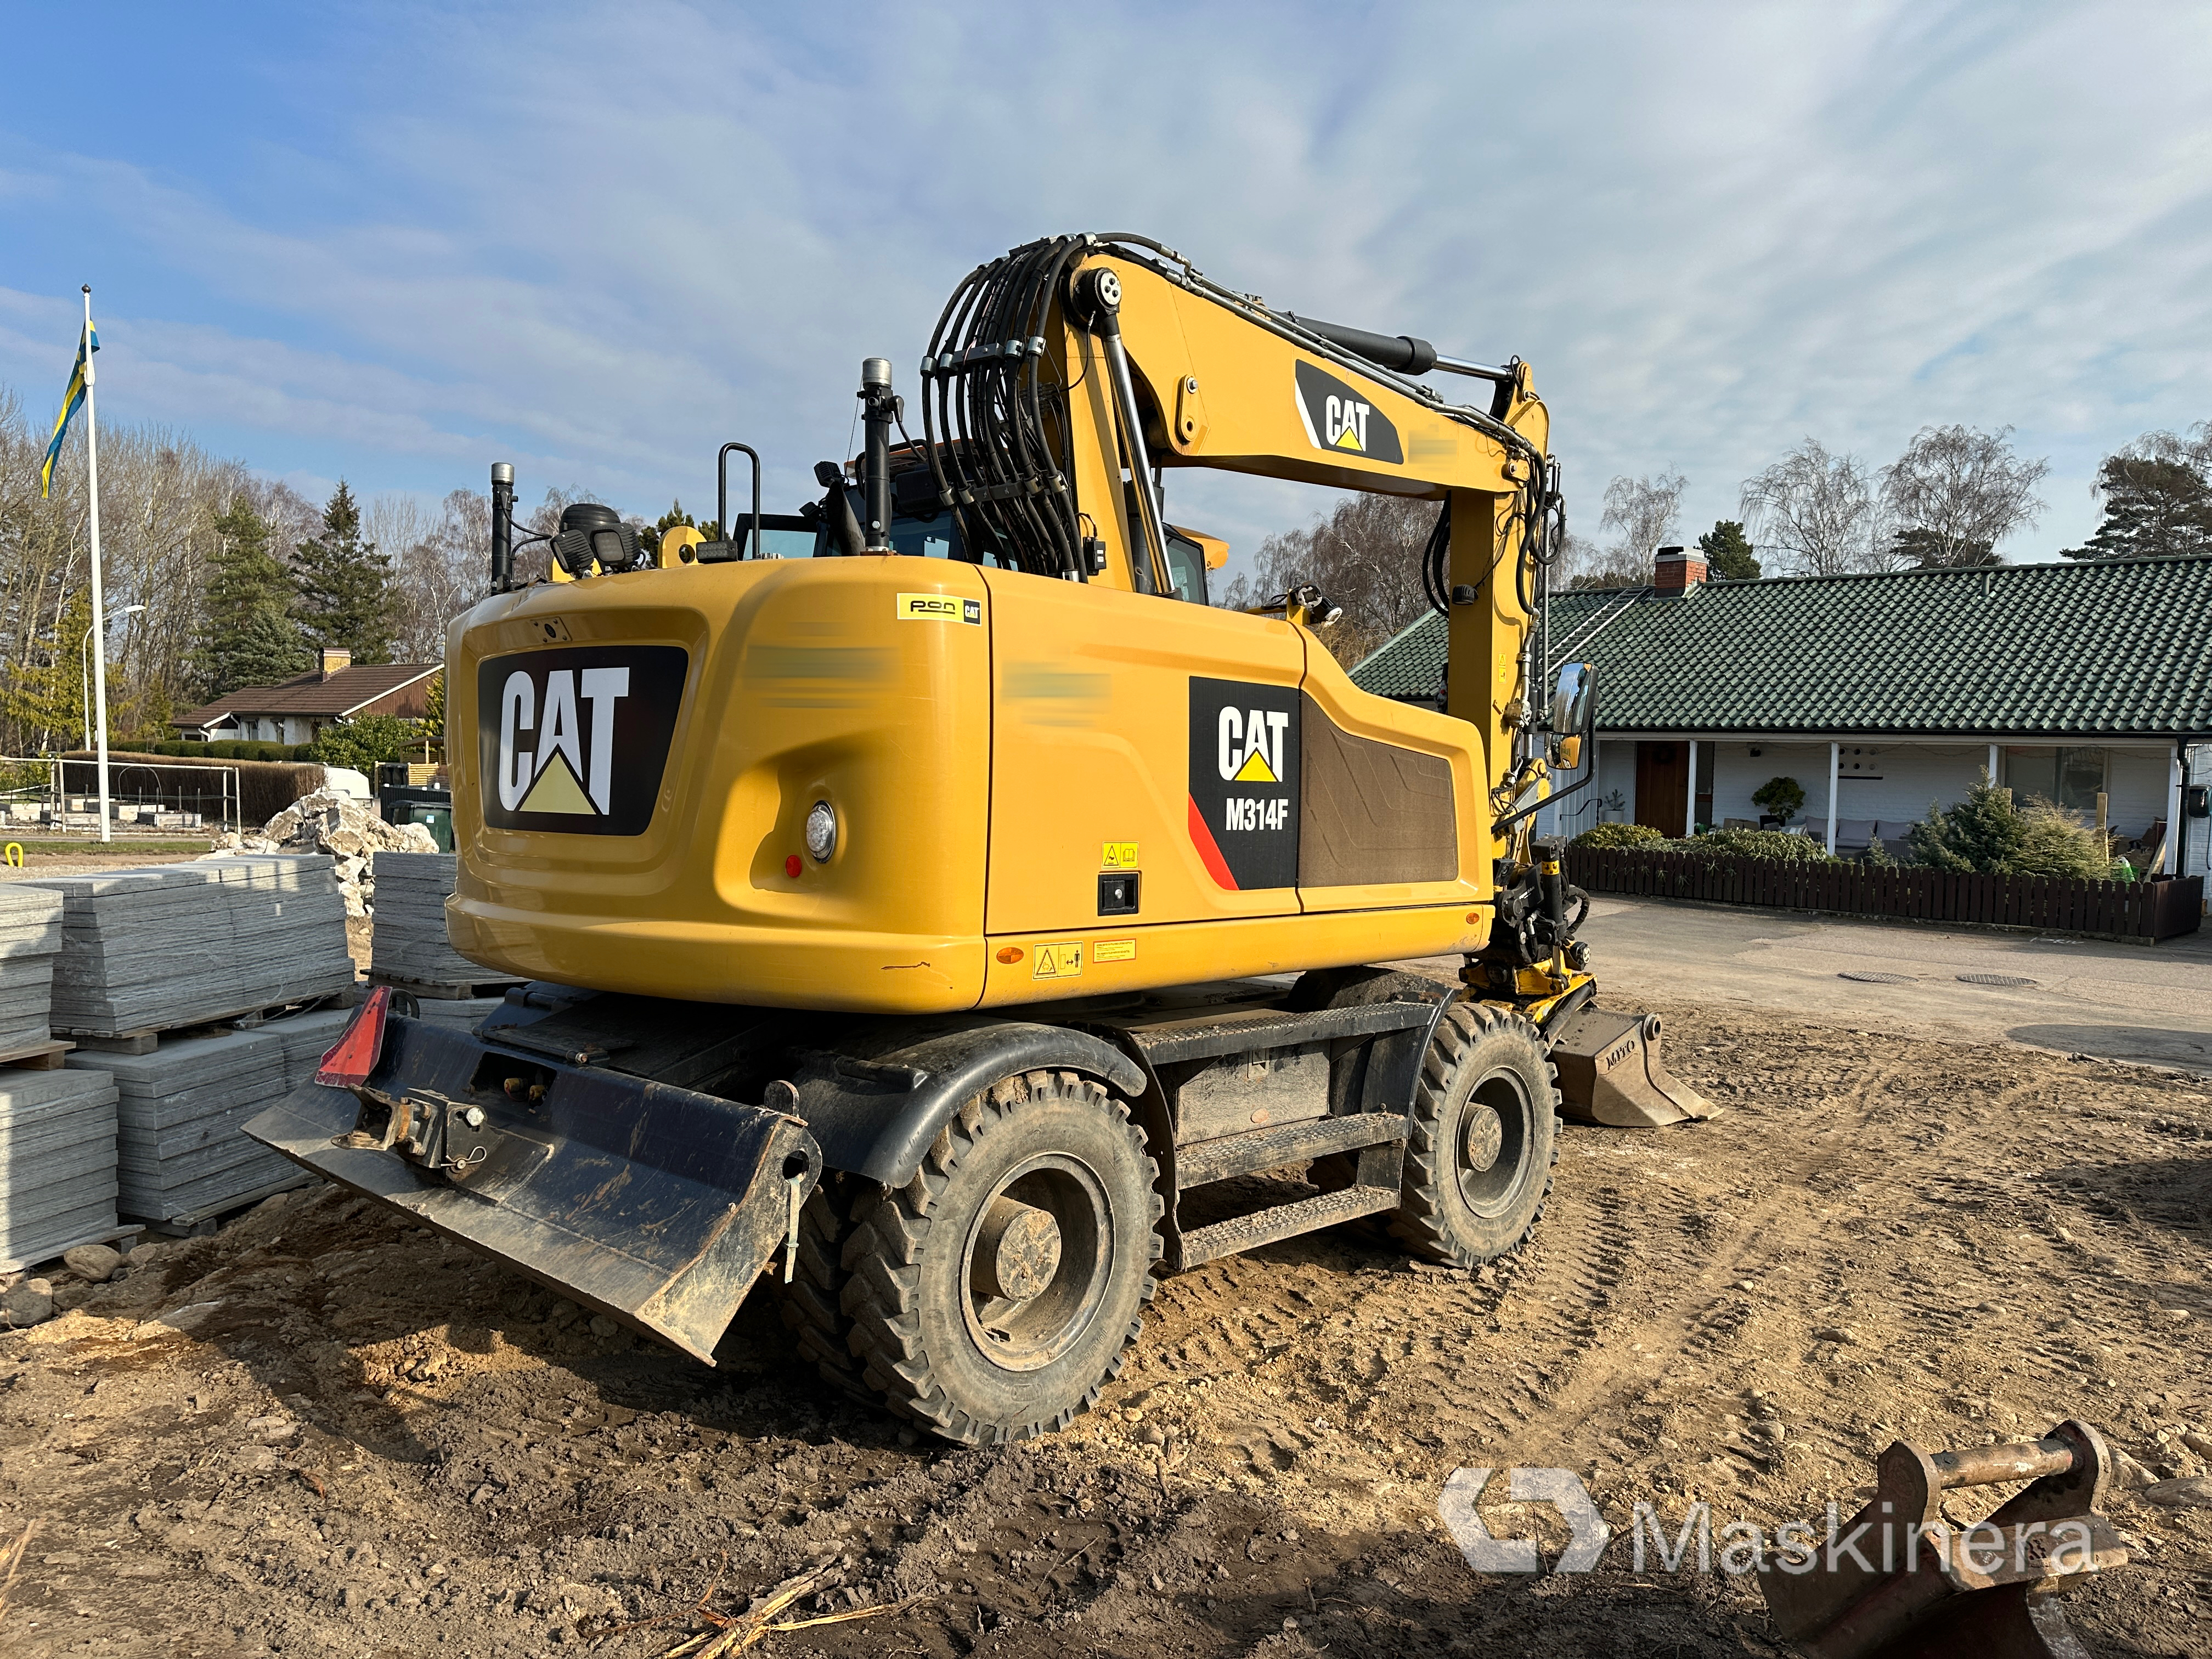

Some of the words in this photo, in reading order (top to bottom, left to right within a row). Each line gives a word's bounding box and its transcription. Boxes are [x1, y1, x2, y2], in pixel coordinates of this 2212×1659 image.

[1325, 395, 1370, 452] CAT
[964, 605, 980, 619] CAT
[498, 667, 630, 816] CAT
[1218, 706, 1289, 783] CAT
[1225, 797, 1289, 831] M314F
